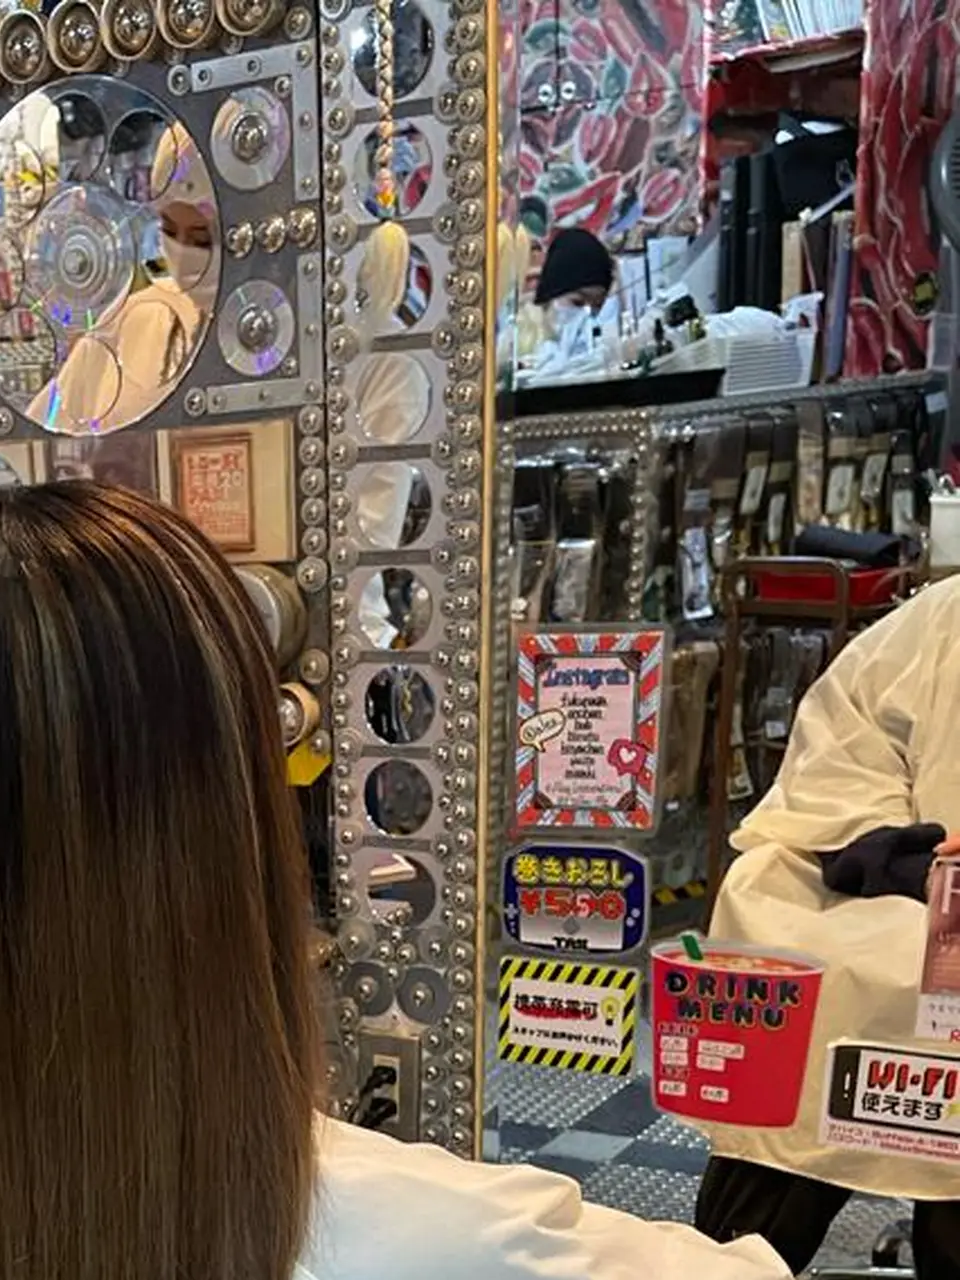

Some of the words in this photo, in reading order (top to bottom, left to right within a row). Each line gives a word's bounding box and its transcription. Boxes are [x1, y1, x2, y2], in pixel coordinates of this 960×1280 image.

[665, 970, 802, 1007] DRINK
[677, 999, 787, 1030] MENU
[861, 1091, 943, 1121] 使えます
